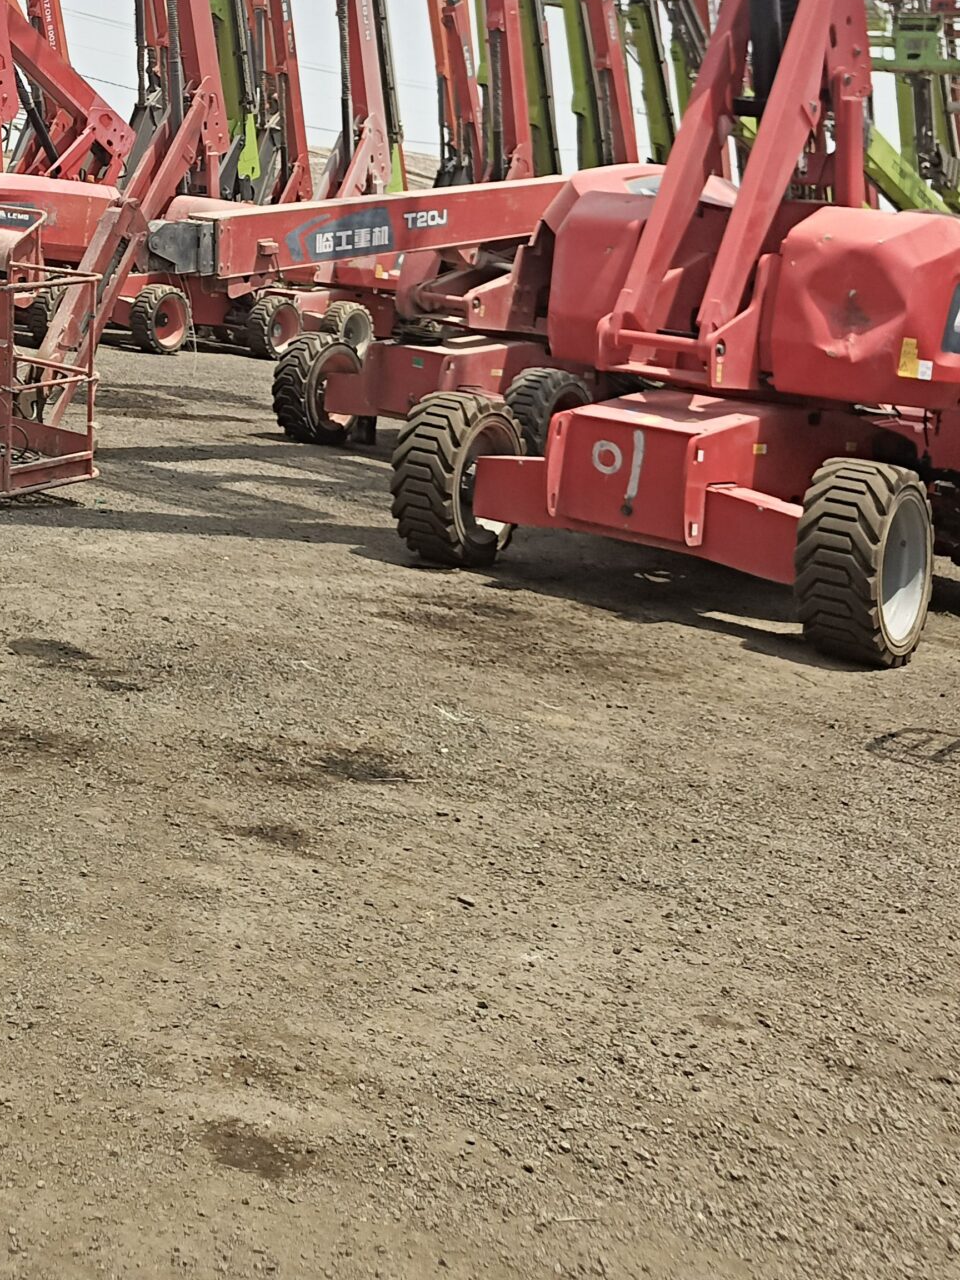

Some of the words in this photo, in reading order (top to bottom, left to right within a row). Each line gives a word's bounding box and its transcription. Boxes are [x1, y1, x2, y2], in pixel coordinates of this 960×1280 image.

[404, 209, 447, 228] T20J
[316, 226, 388, 253] 临工重机
